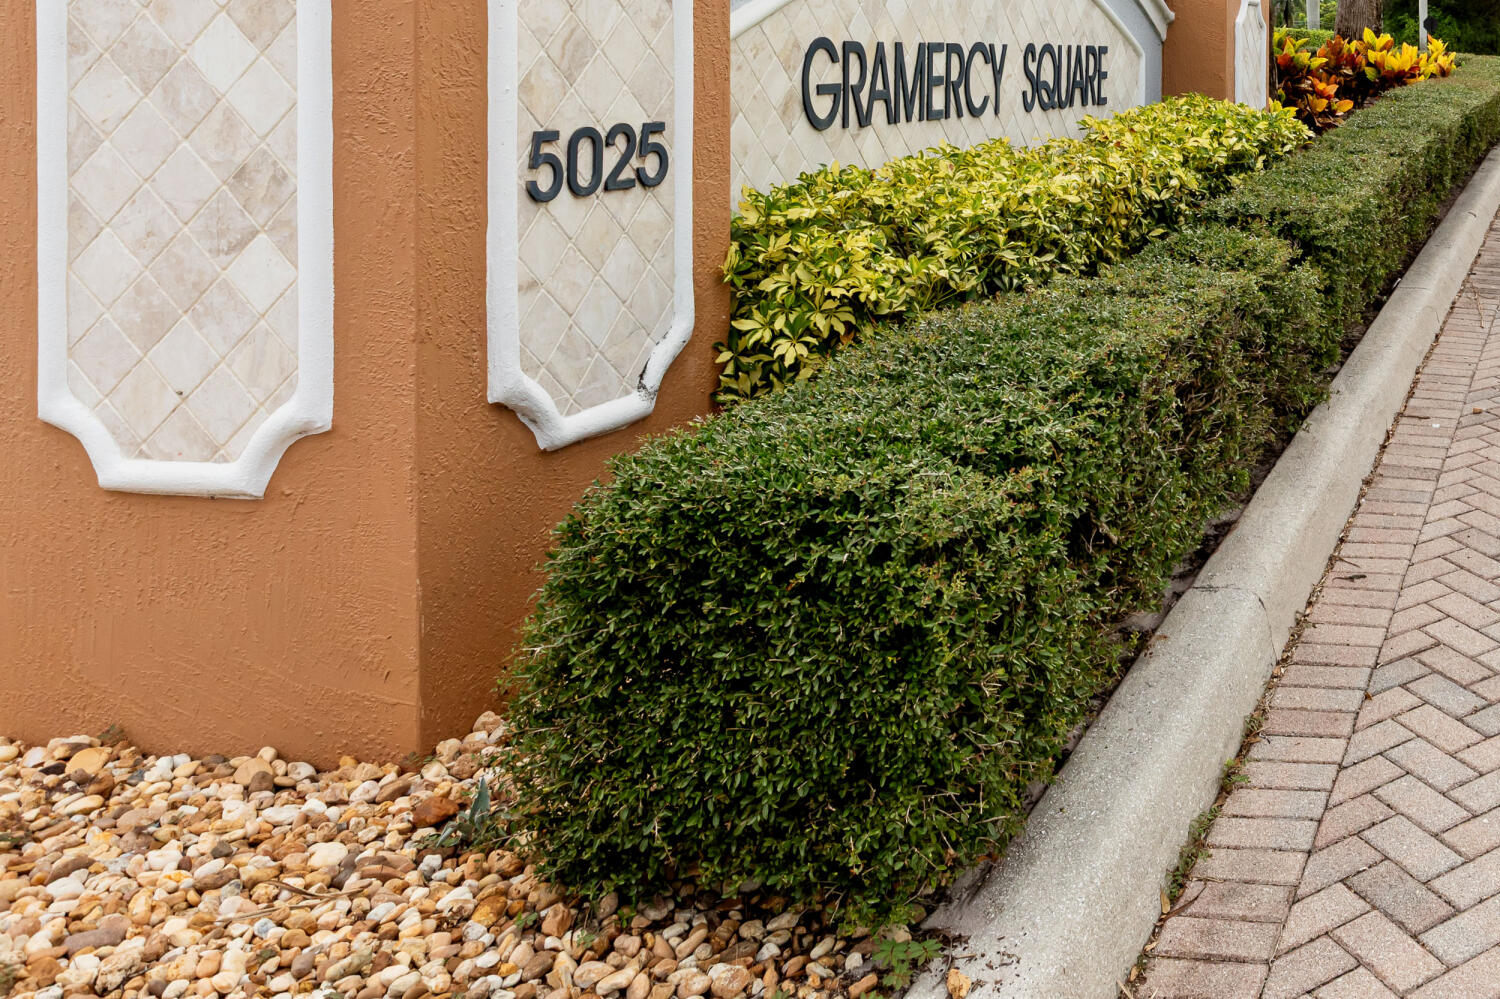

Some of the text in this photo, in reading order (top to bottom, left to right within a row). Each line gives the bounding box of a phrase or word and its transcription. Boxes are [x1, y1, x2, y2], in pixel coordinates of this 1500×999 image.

[802, 36, 1108, 131] GRAMERCY SQUARE
[526, 121, 669, 203] 5025
